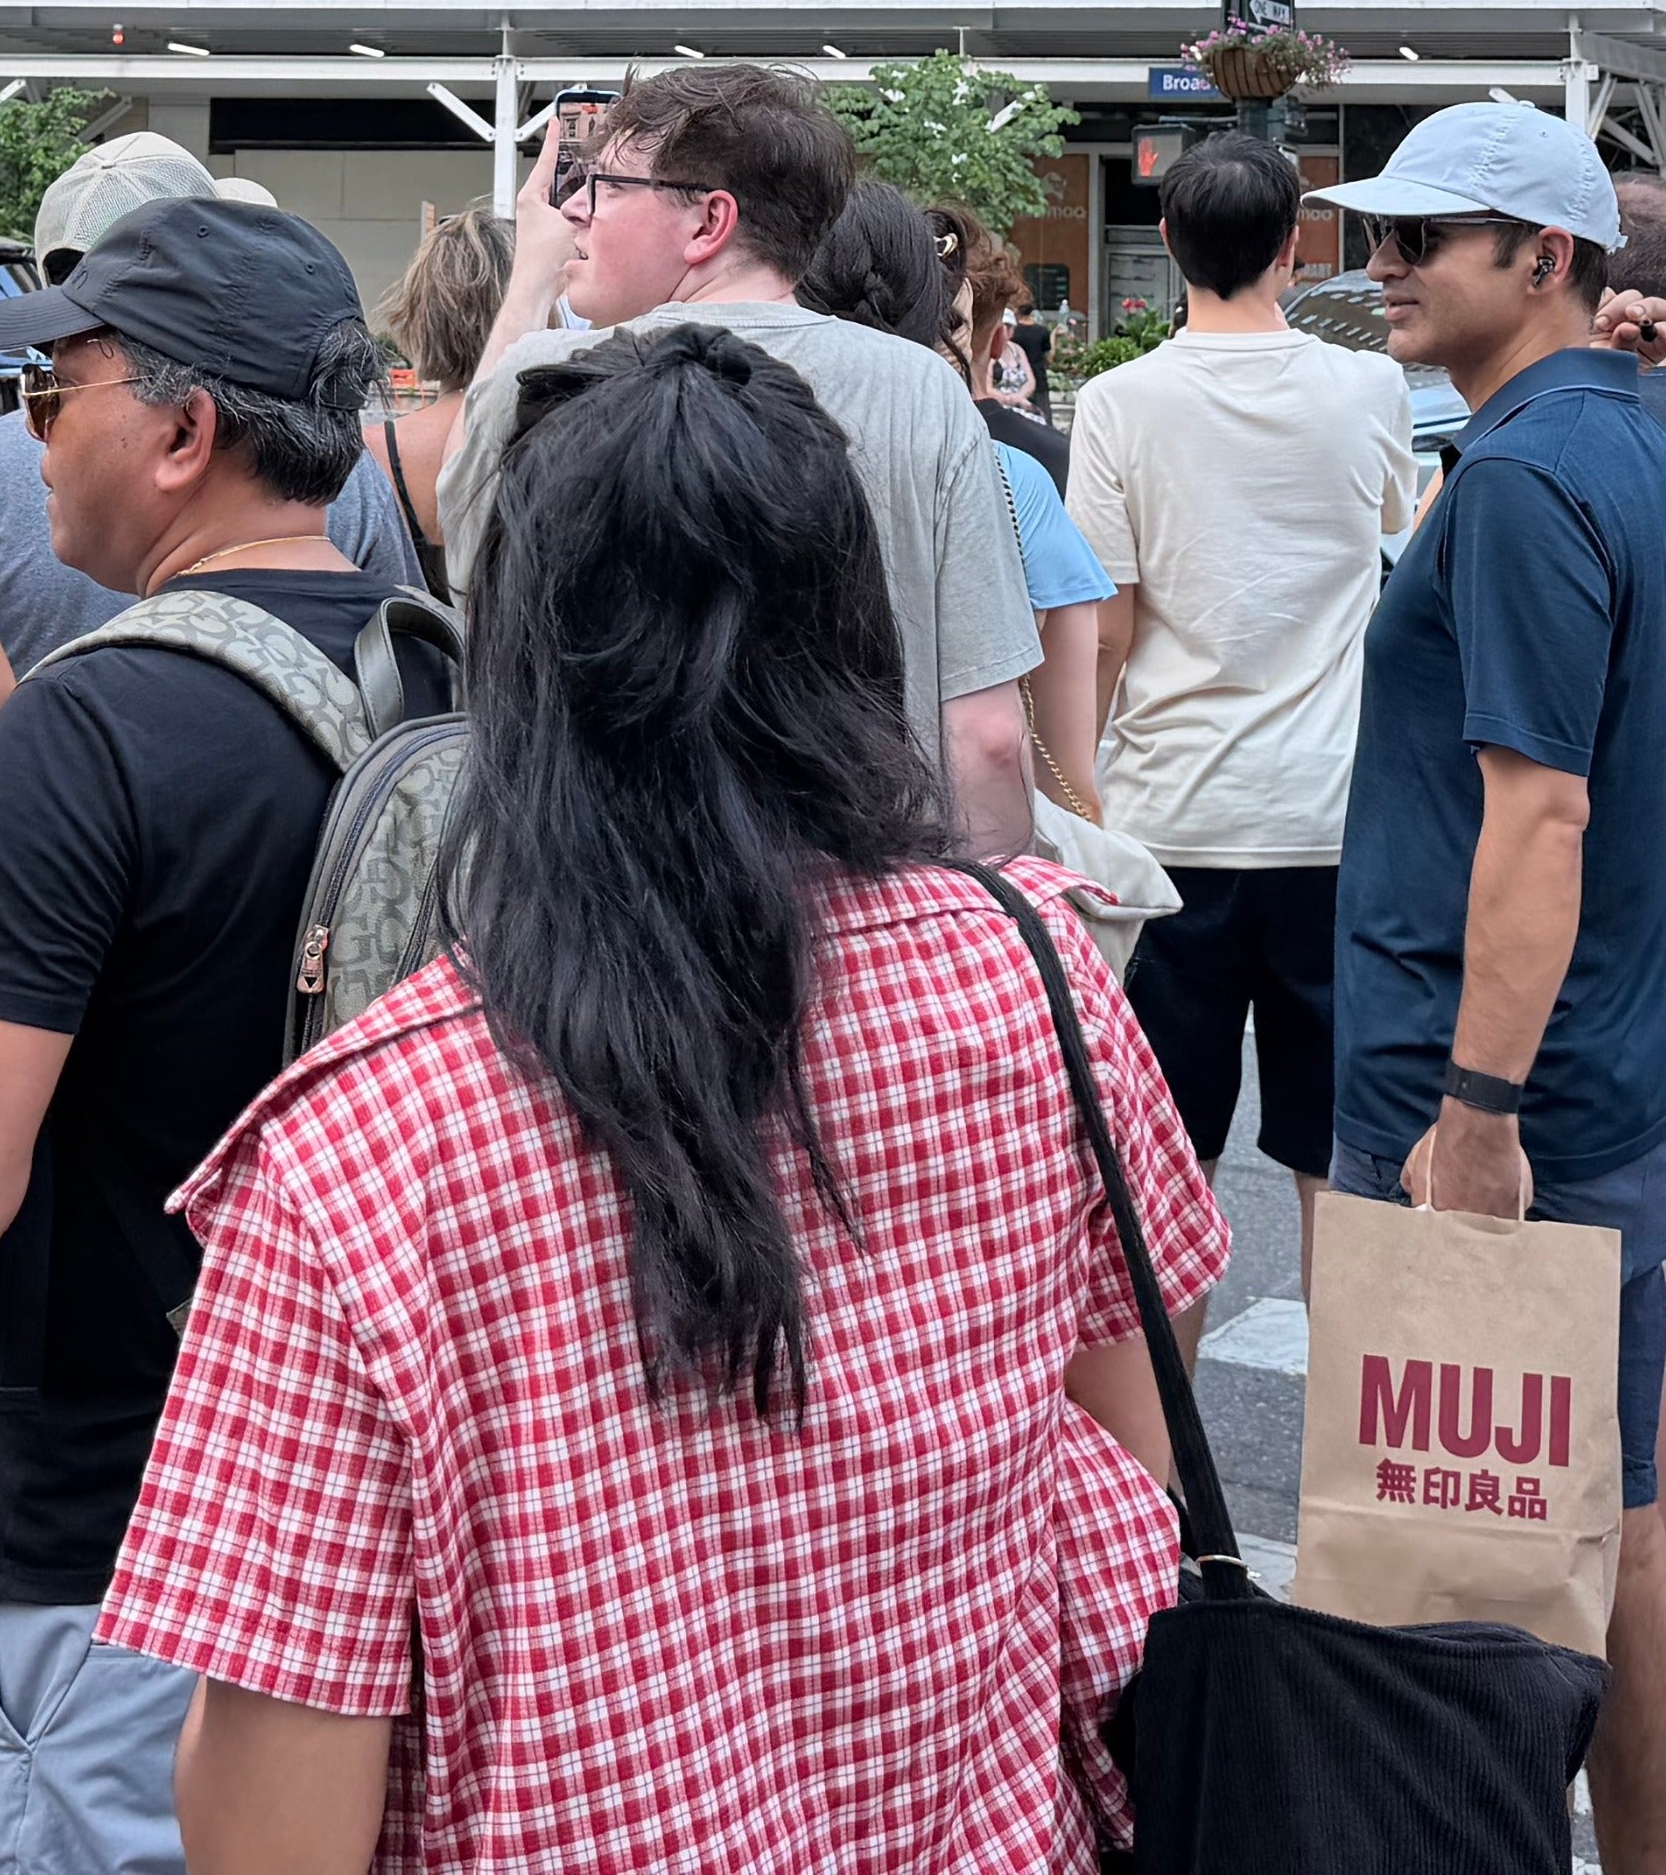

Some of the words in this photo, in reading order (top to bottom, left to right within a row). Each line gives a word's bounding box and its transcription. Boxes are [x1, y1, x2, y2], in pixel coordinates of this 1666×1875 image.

[1254, 0, 1268, 17] ONE
[1273, 5, 1286, 21] WAY
[1358, 1354, 1572, 1468] MUJI
[1375, 1458, 1548, 1521] 無印良品
